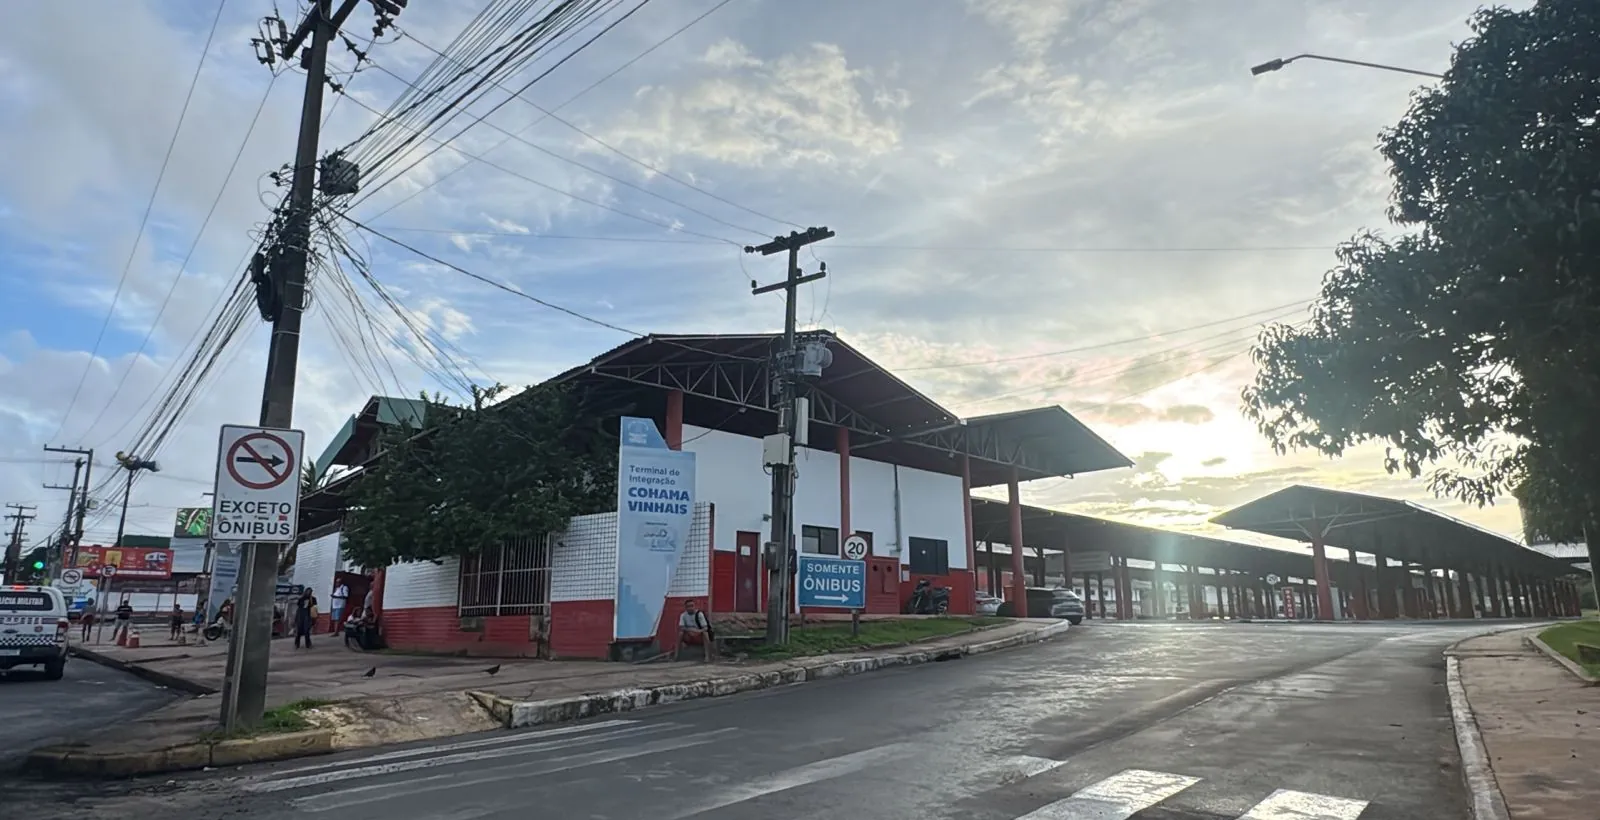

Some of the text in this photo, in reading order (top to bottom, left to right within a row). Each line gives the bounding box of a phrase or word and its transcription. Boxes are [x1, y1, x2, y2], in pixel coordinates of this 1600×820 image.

[629, 464, 667, 475] Terminal
[629, 475, 676, 486] Integração
[628, 487, 690, 501] COHAMA
[220, 500, 292, 515] EXCETO
[628, 500, 688, 515] VINHAIS
[848, 542, 864, 555] 20
[807, 564, 859, 574] SOMENTE
[804, 575, 860, 592] ÔNIBUS
